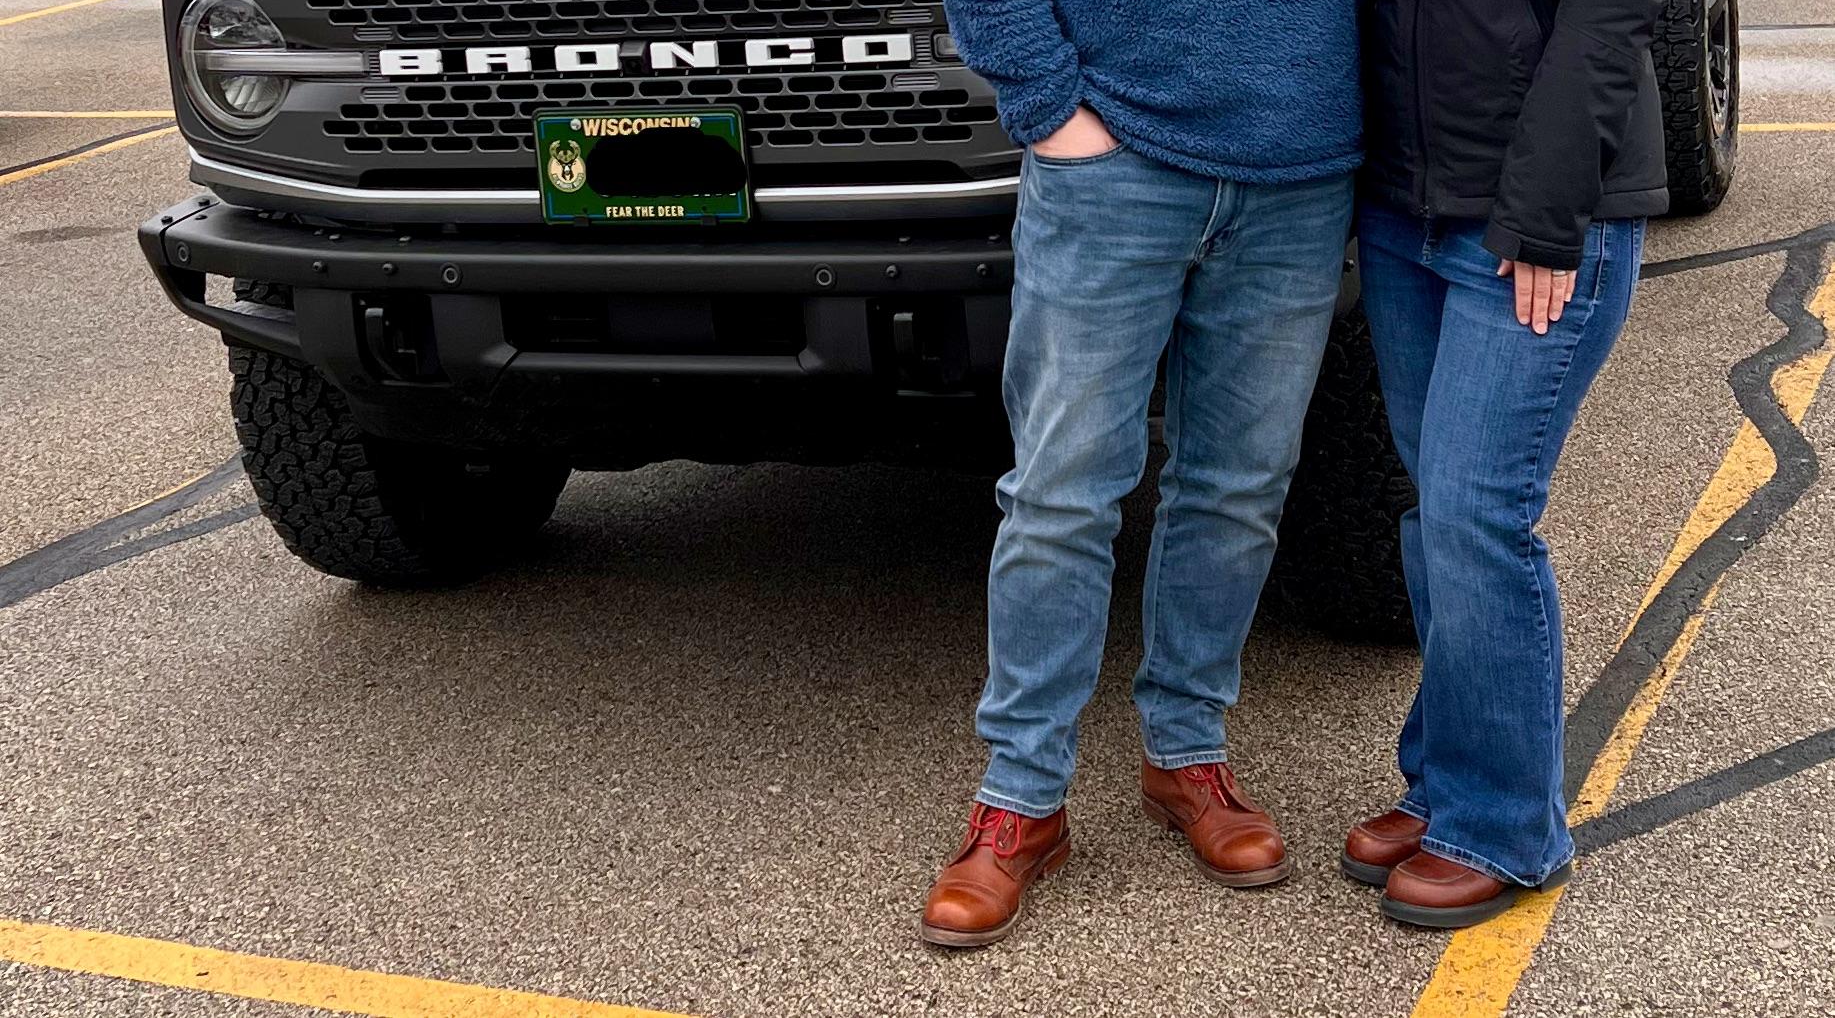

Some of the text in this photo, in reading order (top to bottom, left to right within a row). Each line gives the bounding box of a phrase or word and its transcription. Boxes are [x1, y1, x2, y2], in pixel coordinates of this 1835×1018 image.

[379, 33, 912, 76] BRONCO
[605, 205, 685, 218] FEAR THE DEER
